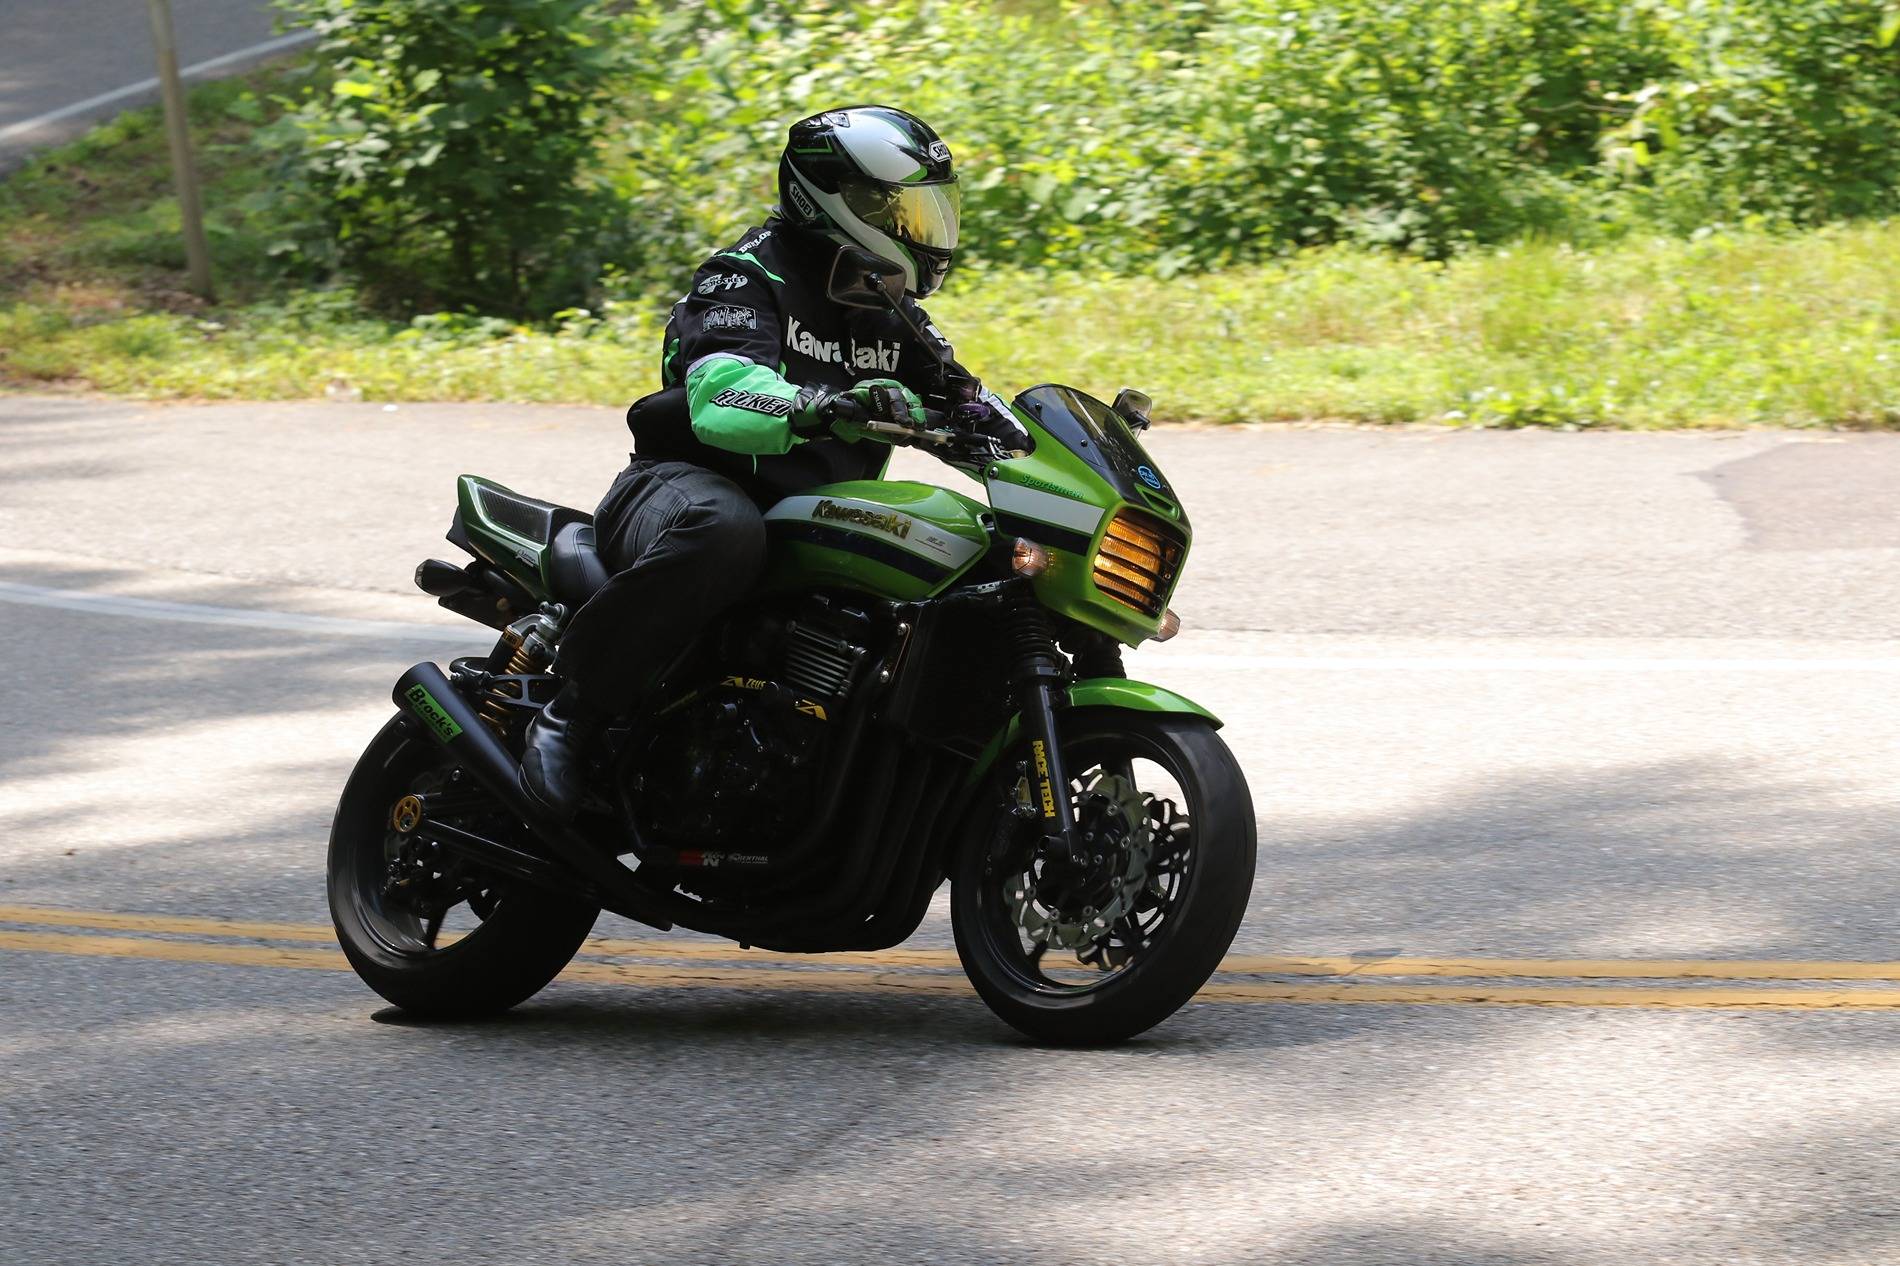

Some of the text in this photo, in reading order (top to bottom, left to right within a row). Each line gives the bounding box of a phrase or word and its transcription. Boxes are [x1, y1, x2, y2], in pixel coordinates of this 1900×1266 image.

[792, 187, 814, 216] SHOEI
[713, 389, 793, 417] RCKET
[811, 500, 912, 540] Kawasaki
[409, 688, 455, 737] Brock's
[1032, 740, 1056, 817] RACE TECH
